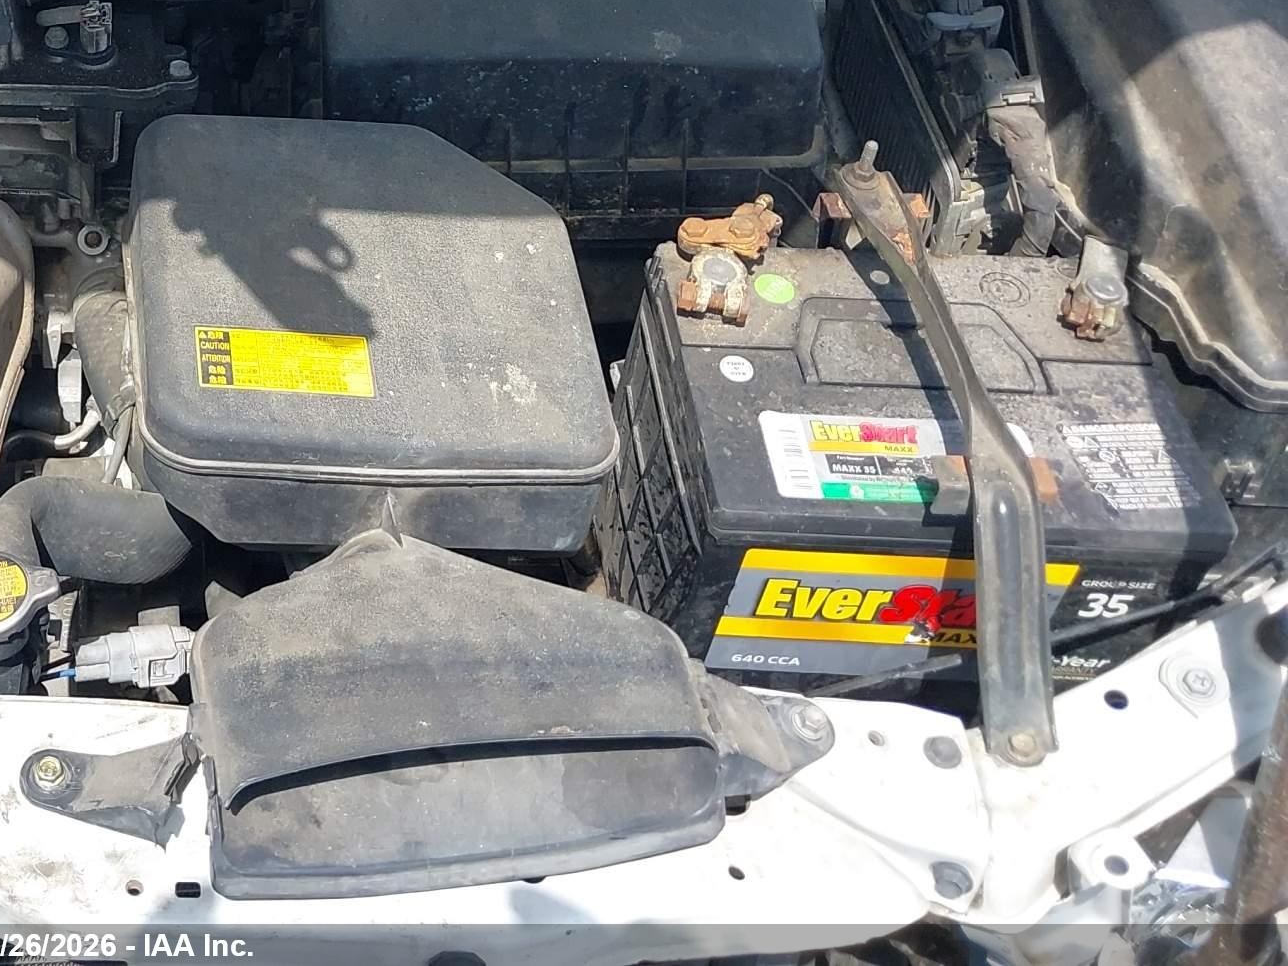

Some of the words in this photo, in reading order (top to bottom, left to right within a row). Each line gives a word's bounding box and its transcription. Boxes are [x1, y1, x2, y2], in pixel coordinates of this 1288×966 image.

[200, 340, 230, 350] CAUTION
[201, 353, 231, 364] ATTENTION
[809, 420, 918, 444] EverStart
[883, 444, 914, 453] MAXX
[832, 463, 862, 474] MAXX
[1081, 580, 1126, 589] GROUP
[1127, 581, 1156, 590] SIZE
[755, 578, 977, 629] EverSta
[1078, 592, 1135, 619] 35
[933, 633, 977, 644] MAX
[731, 654, 765, 664] 640
[767, 656, 801, 666] CCA
